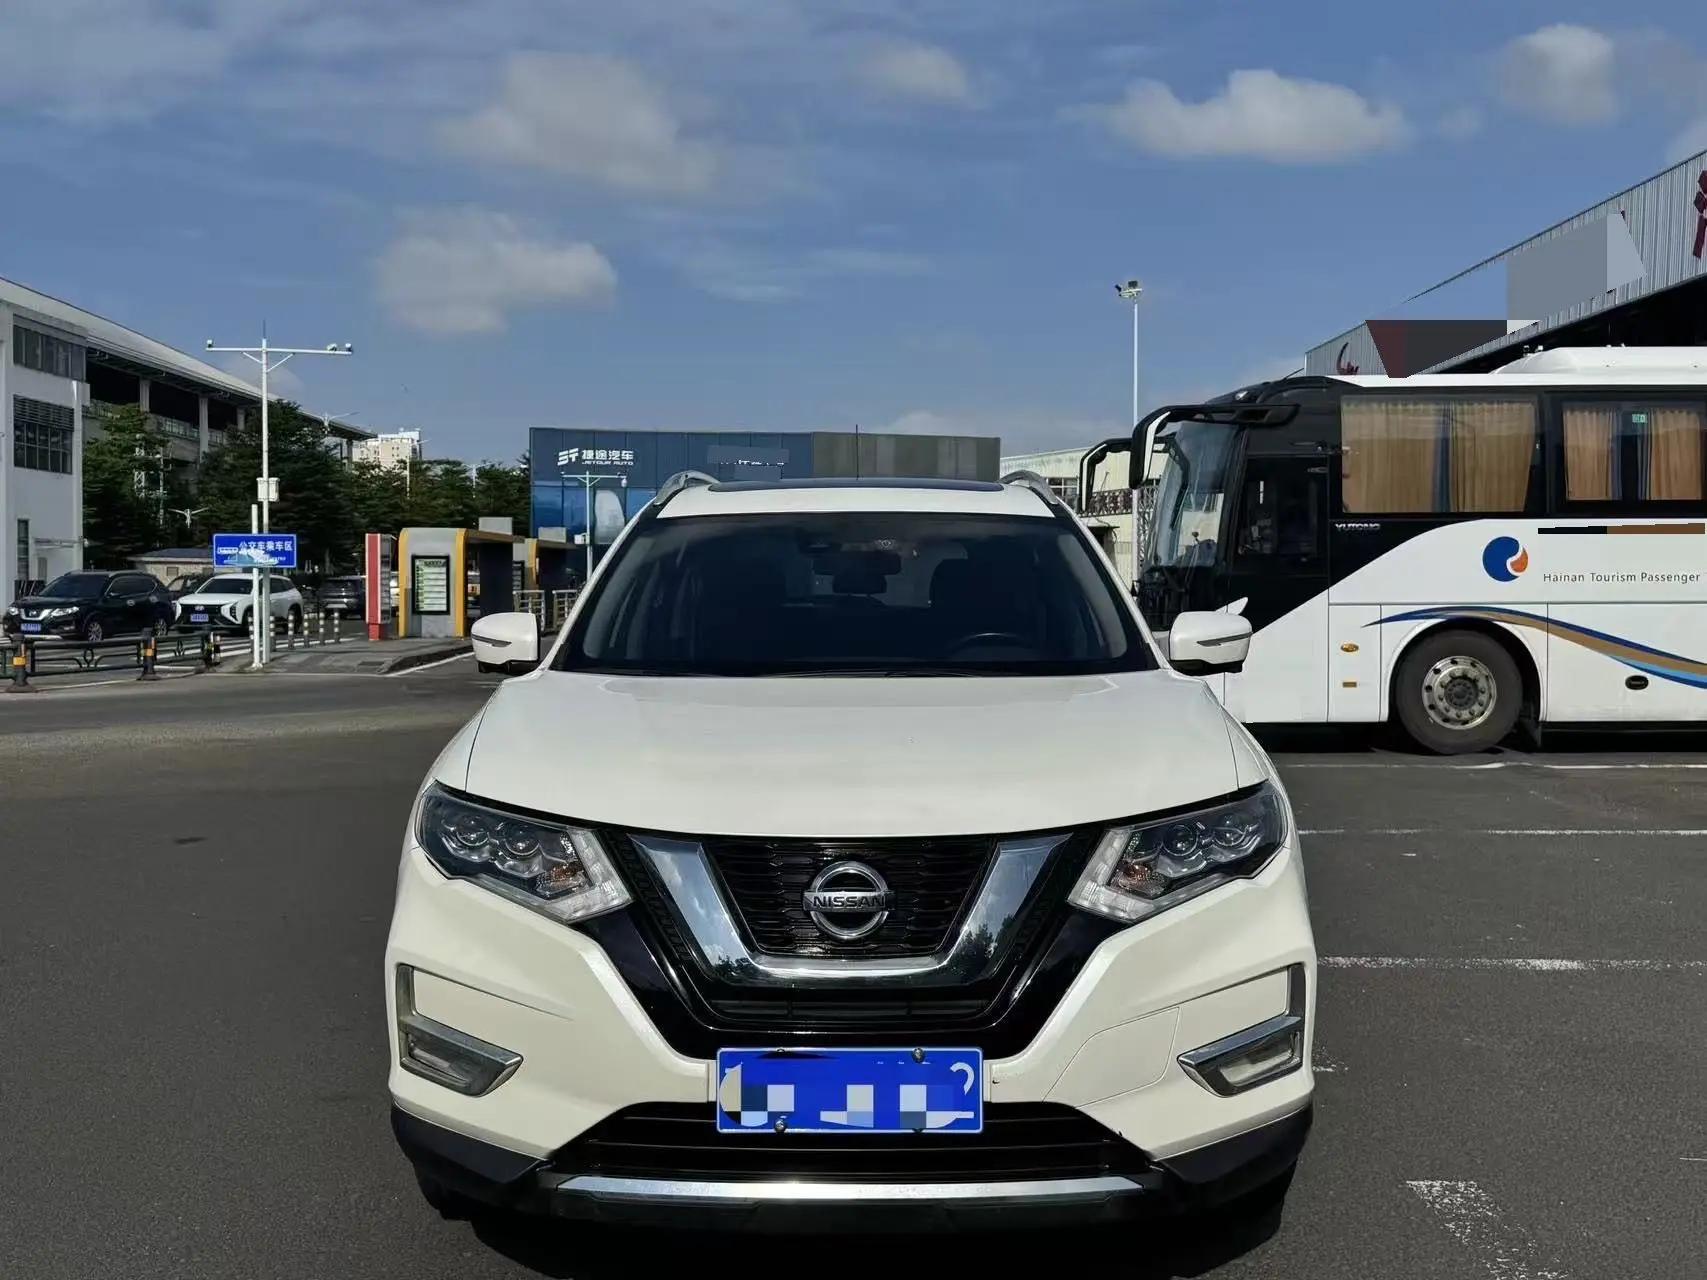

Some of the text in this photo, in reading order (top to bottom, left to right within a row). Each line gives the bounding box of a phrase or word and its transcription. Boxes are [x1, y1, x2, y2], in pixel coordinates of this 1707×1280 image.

[581, 449, 634, 461] 捷途汽车
[1543, 571, 1701, 585] Hainan Tourism Passenger
[813, 895, 885, 908] NISSAN
